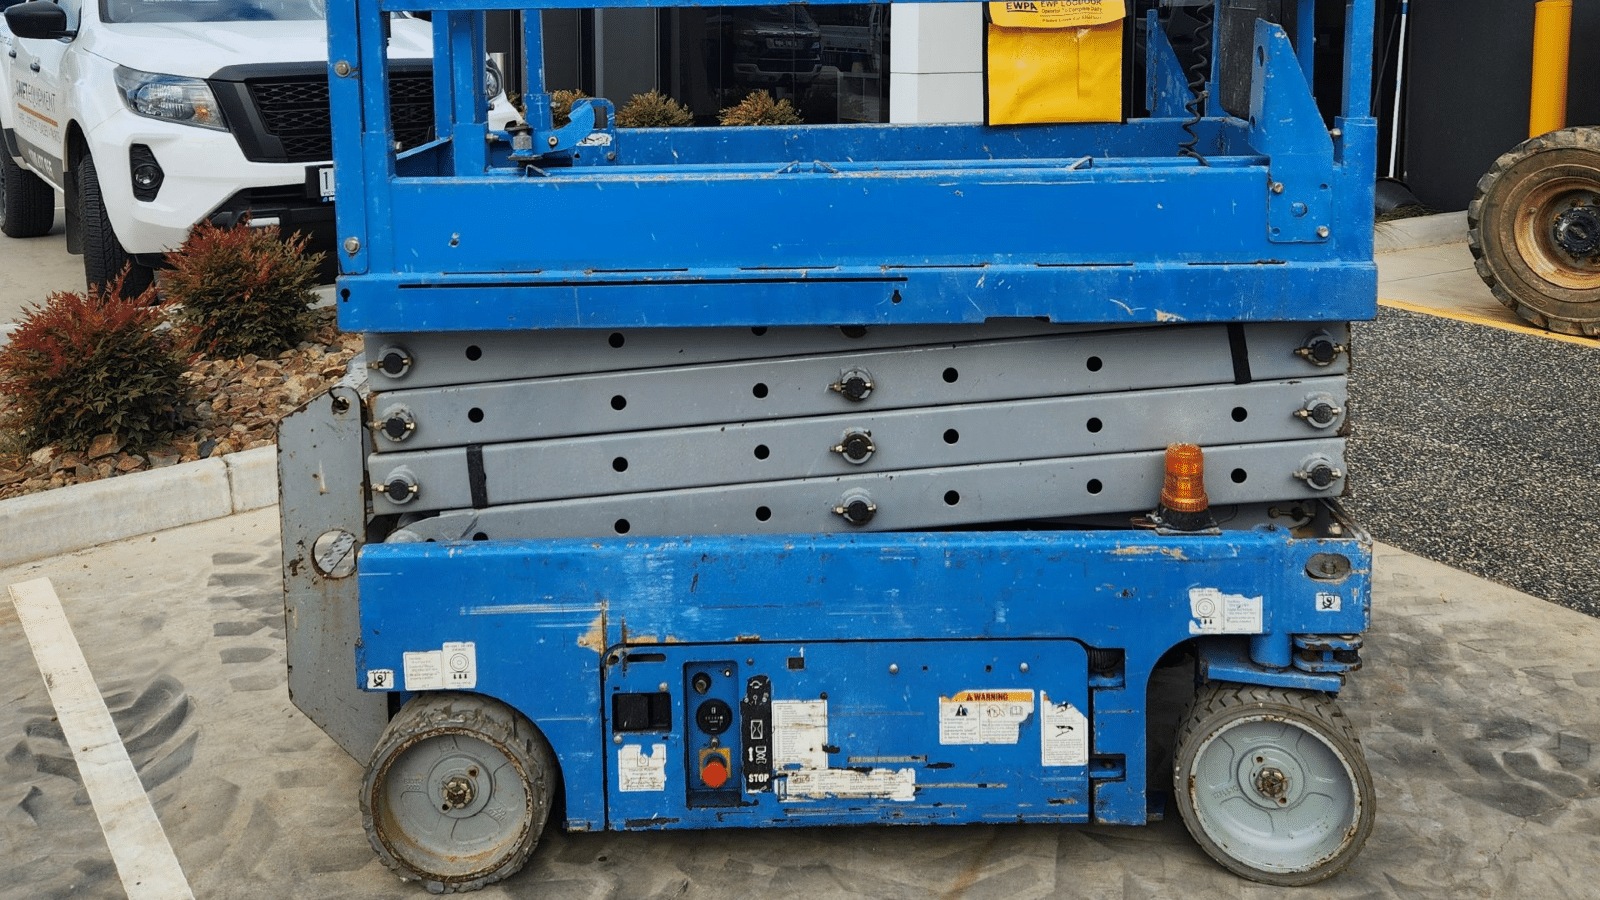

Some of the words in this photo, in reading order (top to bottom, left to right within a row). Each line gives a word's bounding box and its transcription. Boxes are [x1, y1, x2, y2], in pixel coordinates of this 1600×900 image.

[1006, 2, 1038, 10] EWPA
[973, 692, 1009, 701] WARNING
[748, 773, 770, 783] STOP
